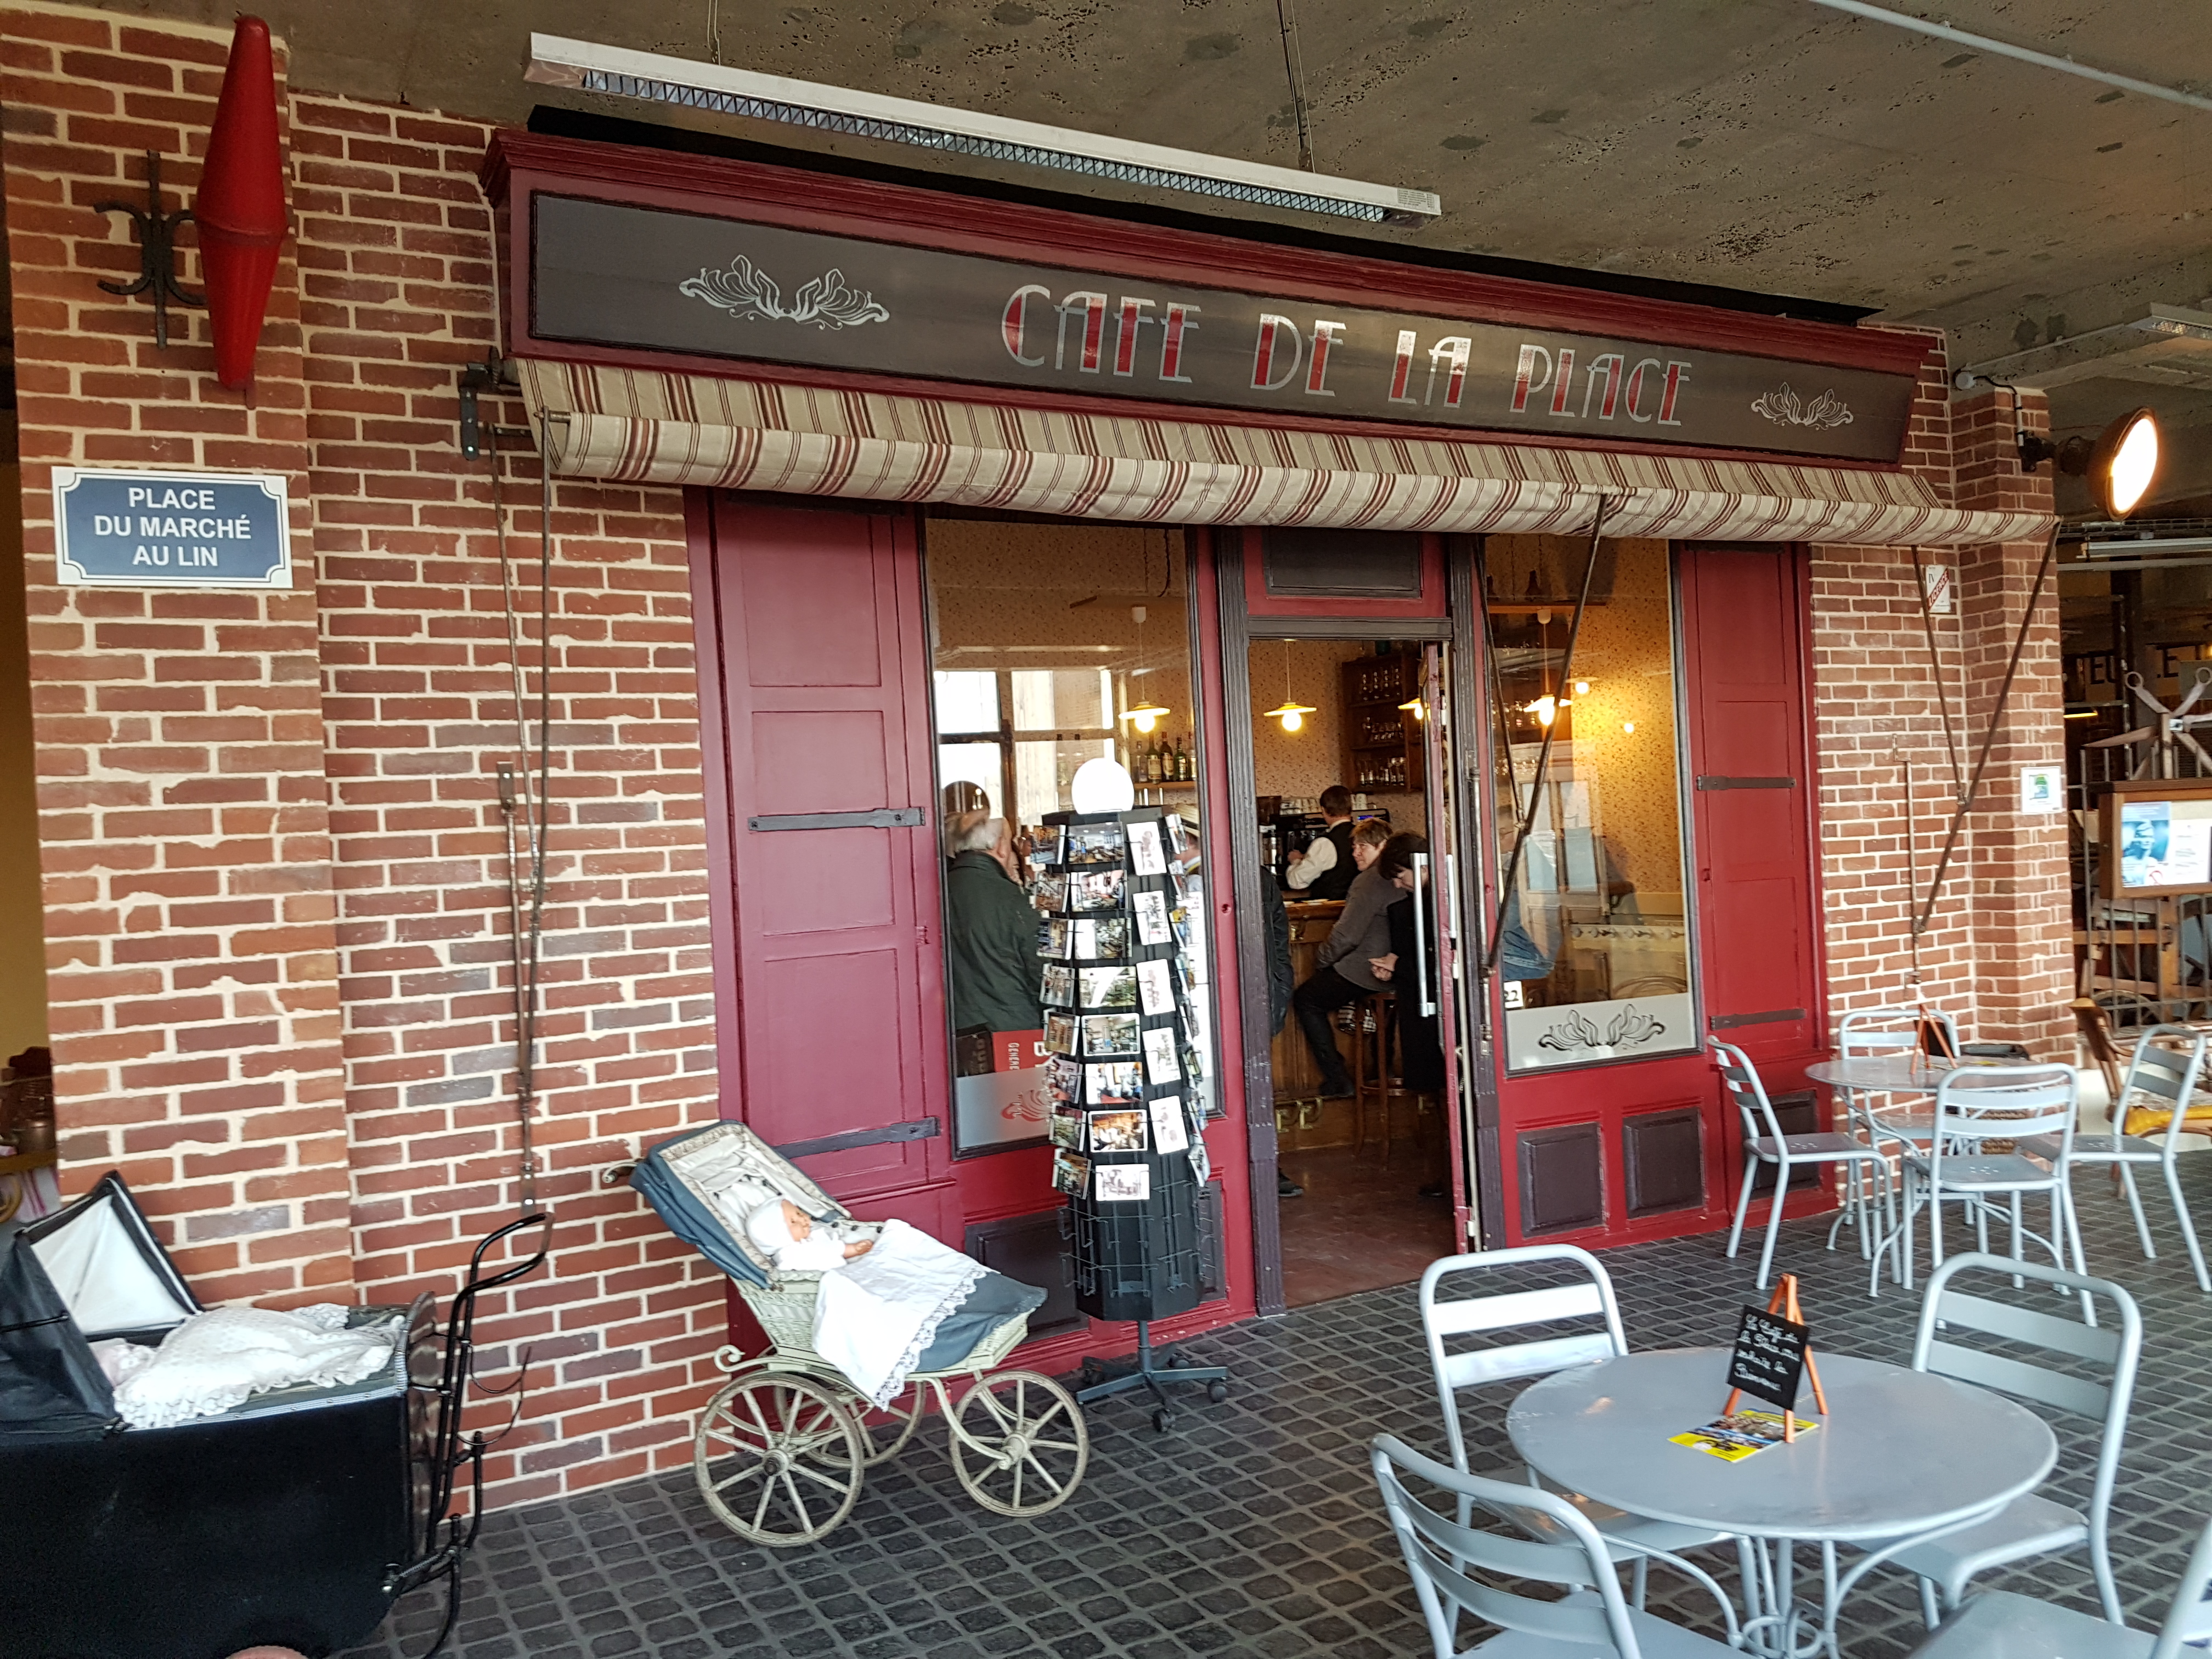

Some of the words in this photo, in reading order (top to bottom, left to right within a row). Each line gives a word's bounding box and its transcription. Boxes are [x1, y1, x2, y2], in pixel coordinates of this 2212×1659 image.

[1002, 284, 1201, 383] CAFE
[1250, 313, 1346, 397] DE
[1388, 330, 1472, 408] LA
[1510, 343, 1692, 426] PLACE
[128, 487, 216, 510] PLACE
[94, 515, 132, 537] DU
[140, 514, 252, 539] MARCHÉ
[132, 545, 170, 566] AU
[177, 546, 218, 567] LIN
[1928, 570, 1949, 606] LICENCE
